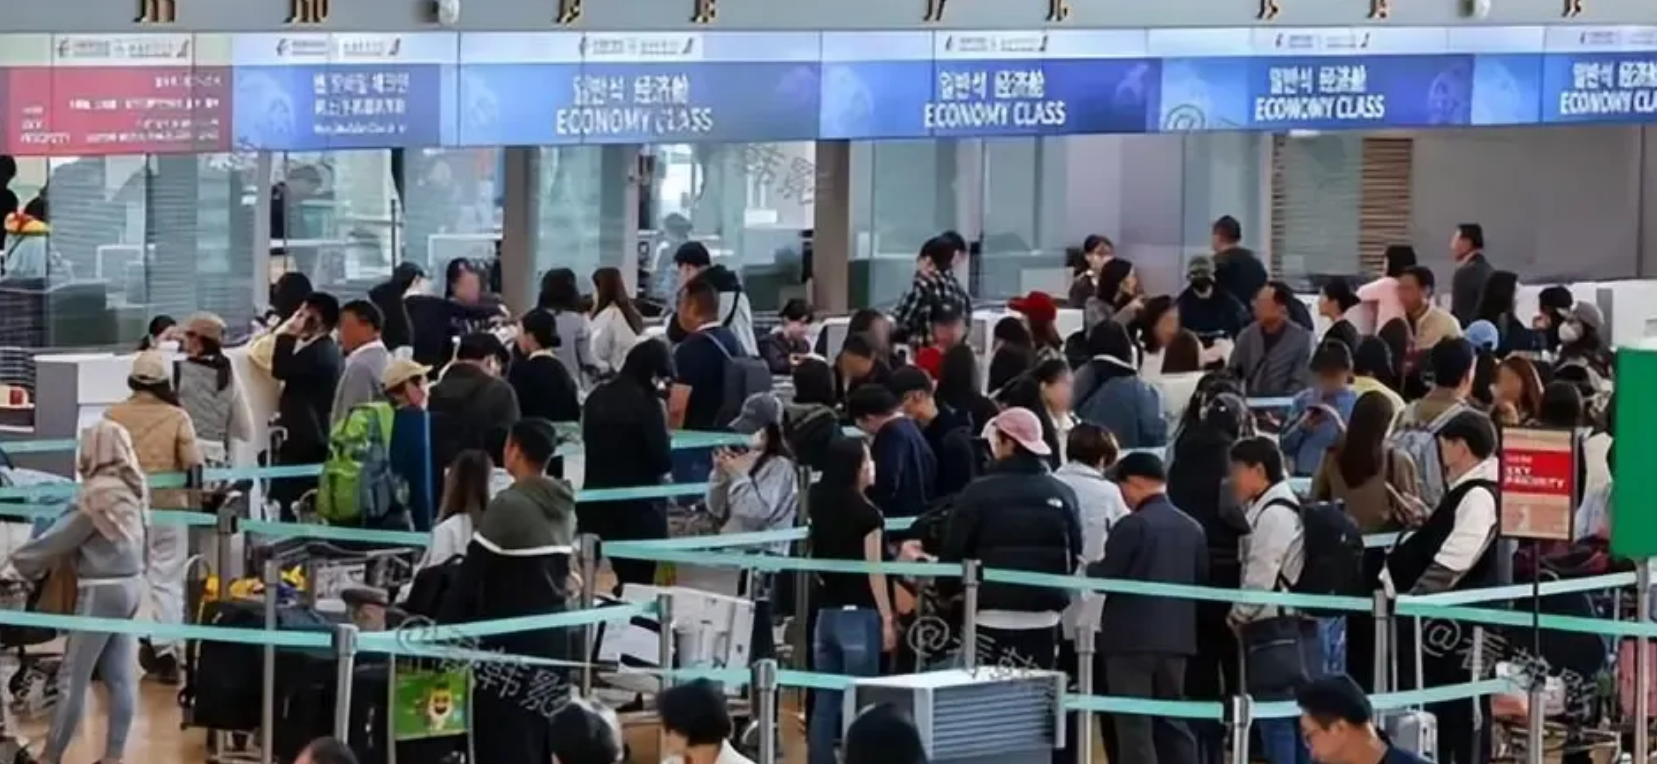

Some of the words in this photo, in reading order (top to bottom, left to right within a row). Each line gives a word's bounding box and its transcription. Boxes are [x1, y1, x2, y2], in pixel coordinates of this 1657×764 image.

[924, 102, 1009, 128] ECONOMY
[1013, 100, 1066, 126] CLASS
[1255, 97, 1334, 122] ECONOMY
[1335, 94, 1386, 119] CLASS
[1560, 91, 1632, 115] ECONOMY
[556, 108, 650, 135] ECONOMY
[655, 107, 714, 134] CLASS
